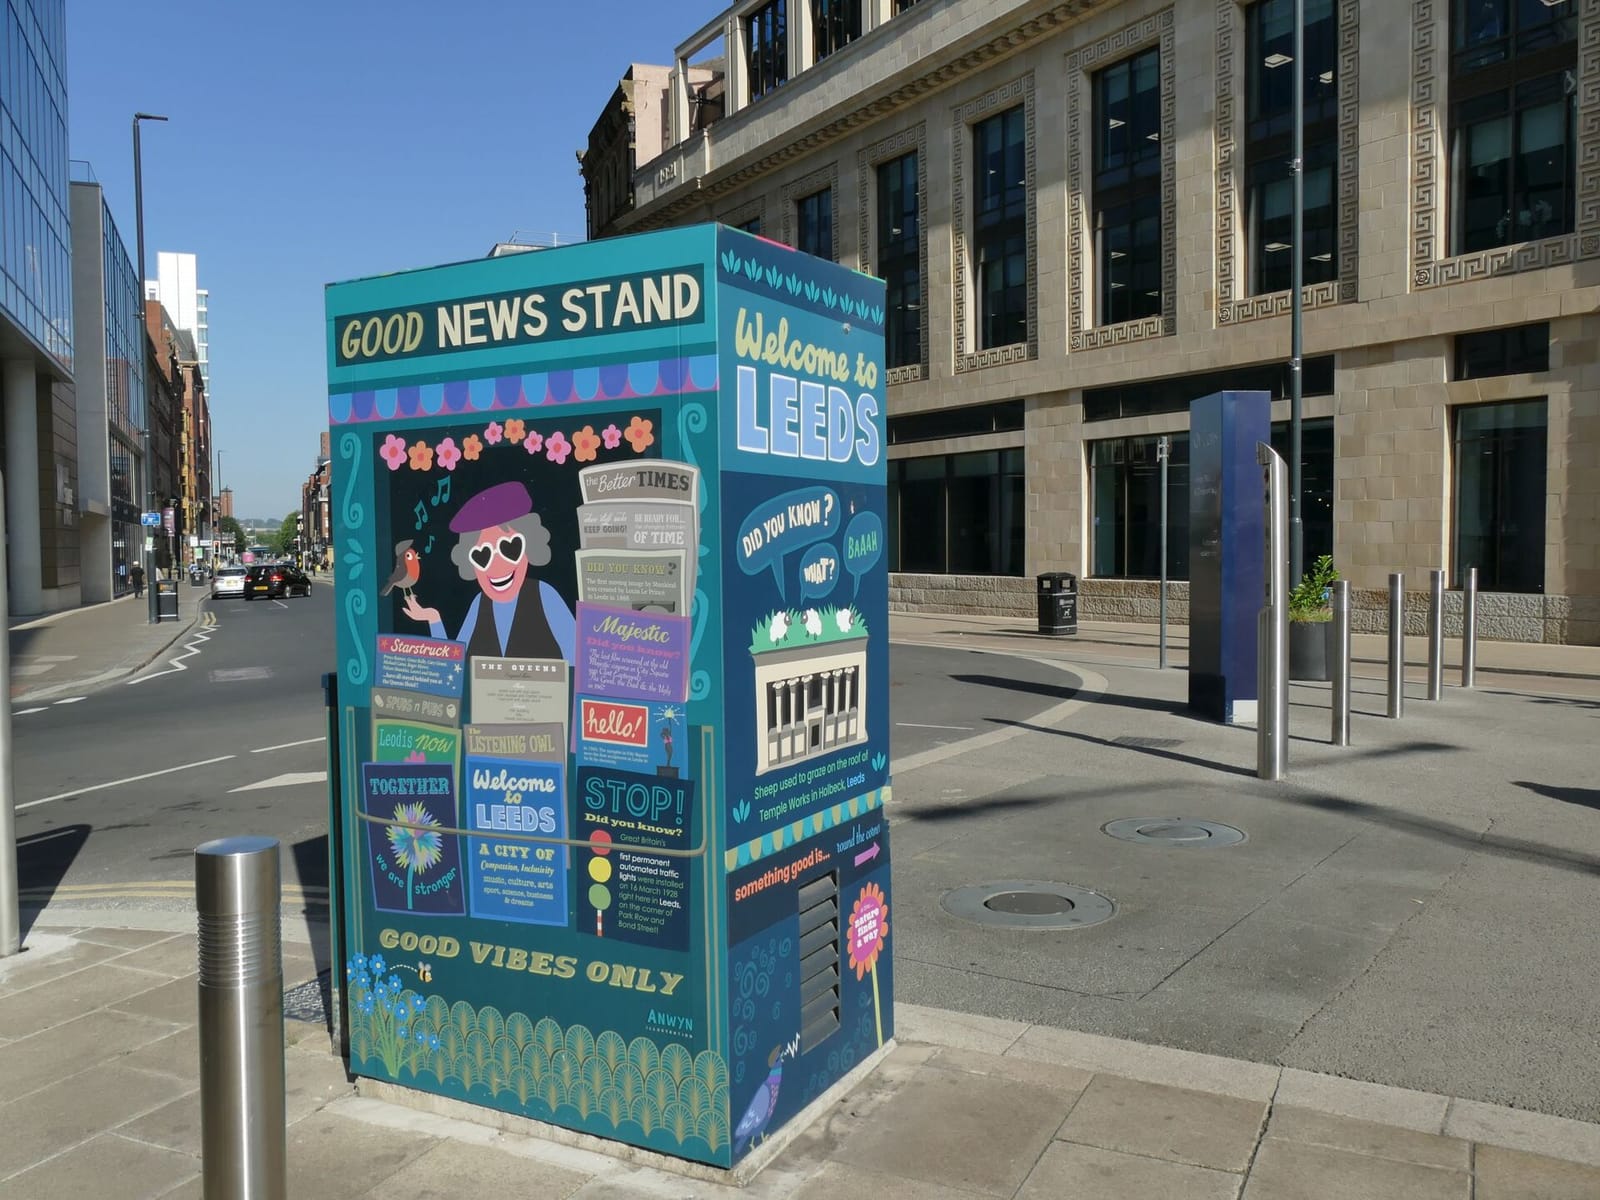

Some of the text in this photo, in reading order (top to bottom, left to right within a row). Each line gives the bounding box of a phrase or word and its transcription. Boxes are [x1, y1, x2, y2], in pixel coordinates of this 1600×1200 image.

[341, 274, 700, 359] GOOD NEWS STAND
[735, 307, 878, 389] Welcome to
[736, 365, 880, 466] LEEDS
[597, 474, 636, 493] Better
[636, 470, 690, 492] TIMES
[633, 531, 685, 546] OF TIME
[742, 527, 763, 558] DID
[763, 512, 785, 543] YOU
[586, 561, 605, 573] DID
[803, 557, 836, 585] WHAT?
[593, 616, 670, 643] Majestic
[391, 638, 450, 657] Starstruck
[481, 663, 557, 673] THE QUEENS
[586, 707, 643, 739] hello!
[379, 729, 413, 749] Leodis
[469, 734, 555, 754] LISTENING OWL
[370, 778, 450, 795] TOGETHER
[473, 769, 556, 793] Welcome
[754, 785, 779, 800] Sheep
[779, 773, 798, 791] used
[798, 772, 807, 784] to
[807, 766, 826, 784] graze
[827, 762, 836, 774] on
[837, 758, 847, 770] the
[848, 751, 860, 768] roof
[504, 790, 522, 804] to
[585, 777, 685, 825] STOP!
[760, 800, 787, 822] Temple
[788, 791, 811, 811] Works
[811, 789, 818, 802] in
[846, 772, 865, 788] Leeds
[476, 803, 556, 833] LEEDS
[584, 813, 682, 837] Did you know?
[620, 833, 641, 844] Great
[479, 843, 555, 861] A CITY OF
[620, 852, 670, 867] first permanent
[376, 853, 405, 889] we are
[415, 867, 457, 896] stronger
[620, 863, 679, 879] automated traffic
[620, 872, 637, 882] lights
[656, 876, 684, 890] installed
[735, 867, 789, 901] something
[791, 851, 814, 879] good
[619, 891, 634, 901] right
[635, 893, 651, 904] here
[652, 897, 659, 905] in
[630, 884, 638, 892] 16
[639, 885, 661, 896] March
[618, 911, 665, 926] Park Row and
[630, 902, 641, 912] the
[641, 905, 664, 915] corner
[665, 908, 673, 917] of
[618, 920, 636, 931] Bond
[379, 928, 684, 995] GOOD VIBES ONLY
[648, 1009, 693, 1031] ANWYN
